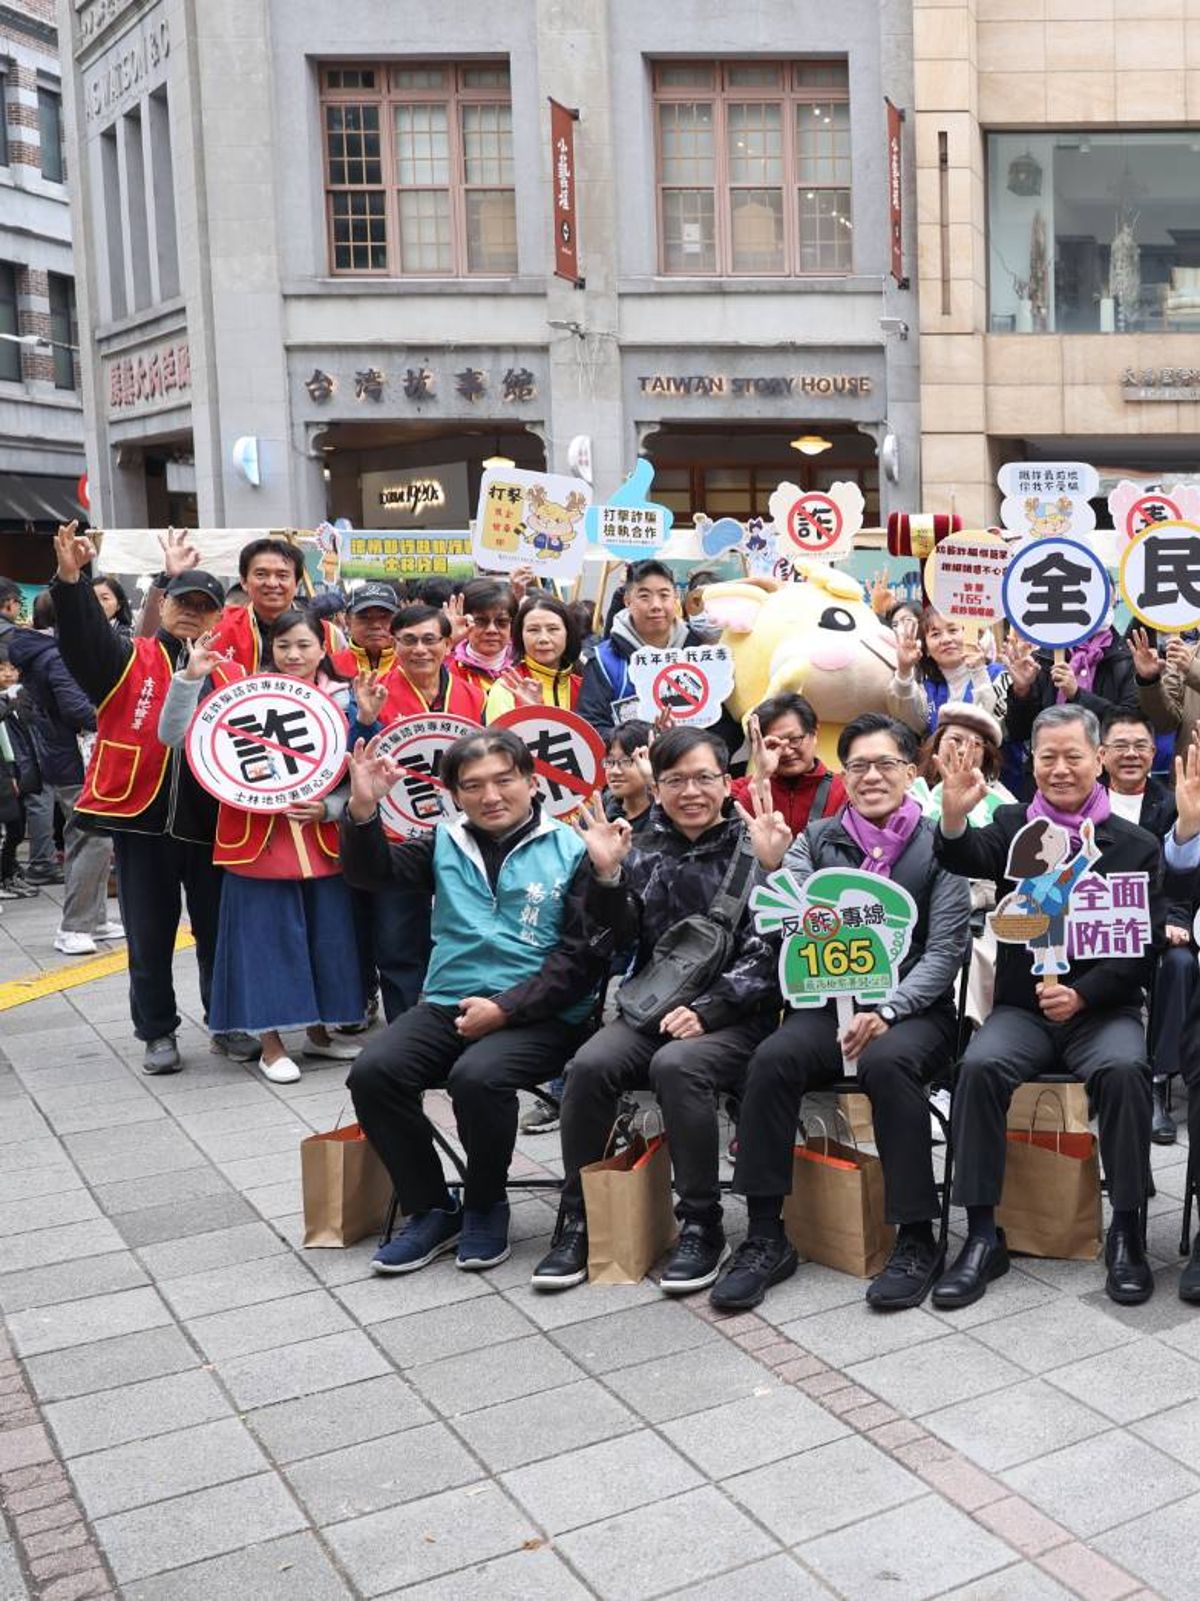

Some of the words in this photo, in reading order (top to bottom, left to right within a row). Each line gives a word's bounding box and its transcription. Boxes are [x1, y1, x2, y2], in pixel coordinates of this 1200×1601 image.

[638, 376, 724, 395] TAIWAN
[731, 376, 794, 395] STORY
[801, 375, 870, 394] HOUSE
[488, 484, 524, 504] 打擊
[603, 508, 657, 524] 打擊詐騙
[1020, 552, 1092, 627] 全
[227, 708, 316, 783] 詐
[379, 720, 468, 754] 詐騙諮詢專線16
[1073, 872, 1147, 912] 全面
[782, 903, 886, 938] 反詐專線
[1075, 918, 1150, 957] 防詐
[799, 938, 875, 977] 165
